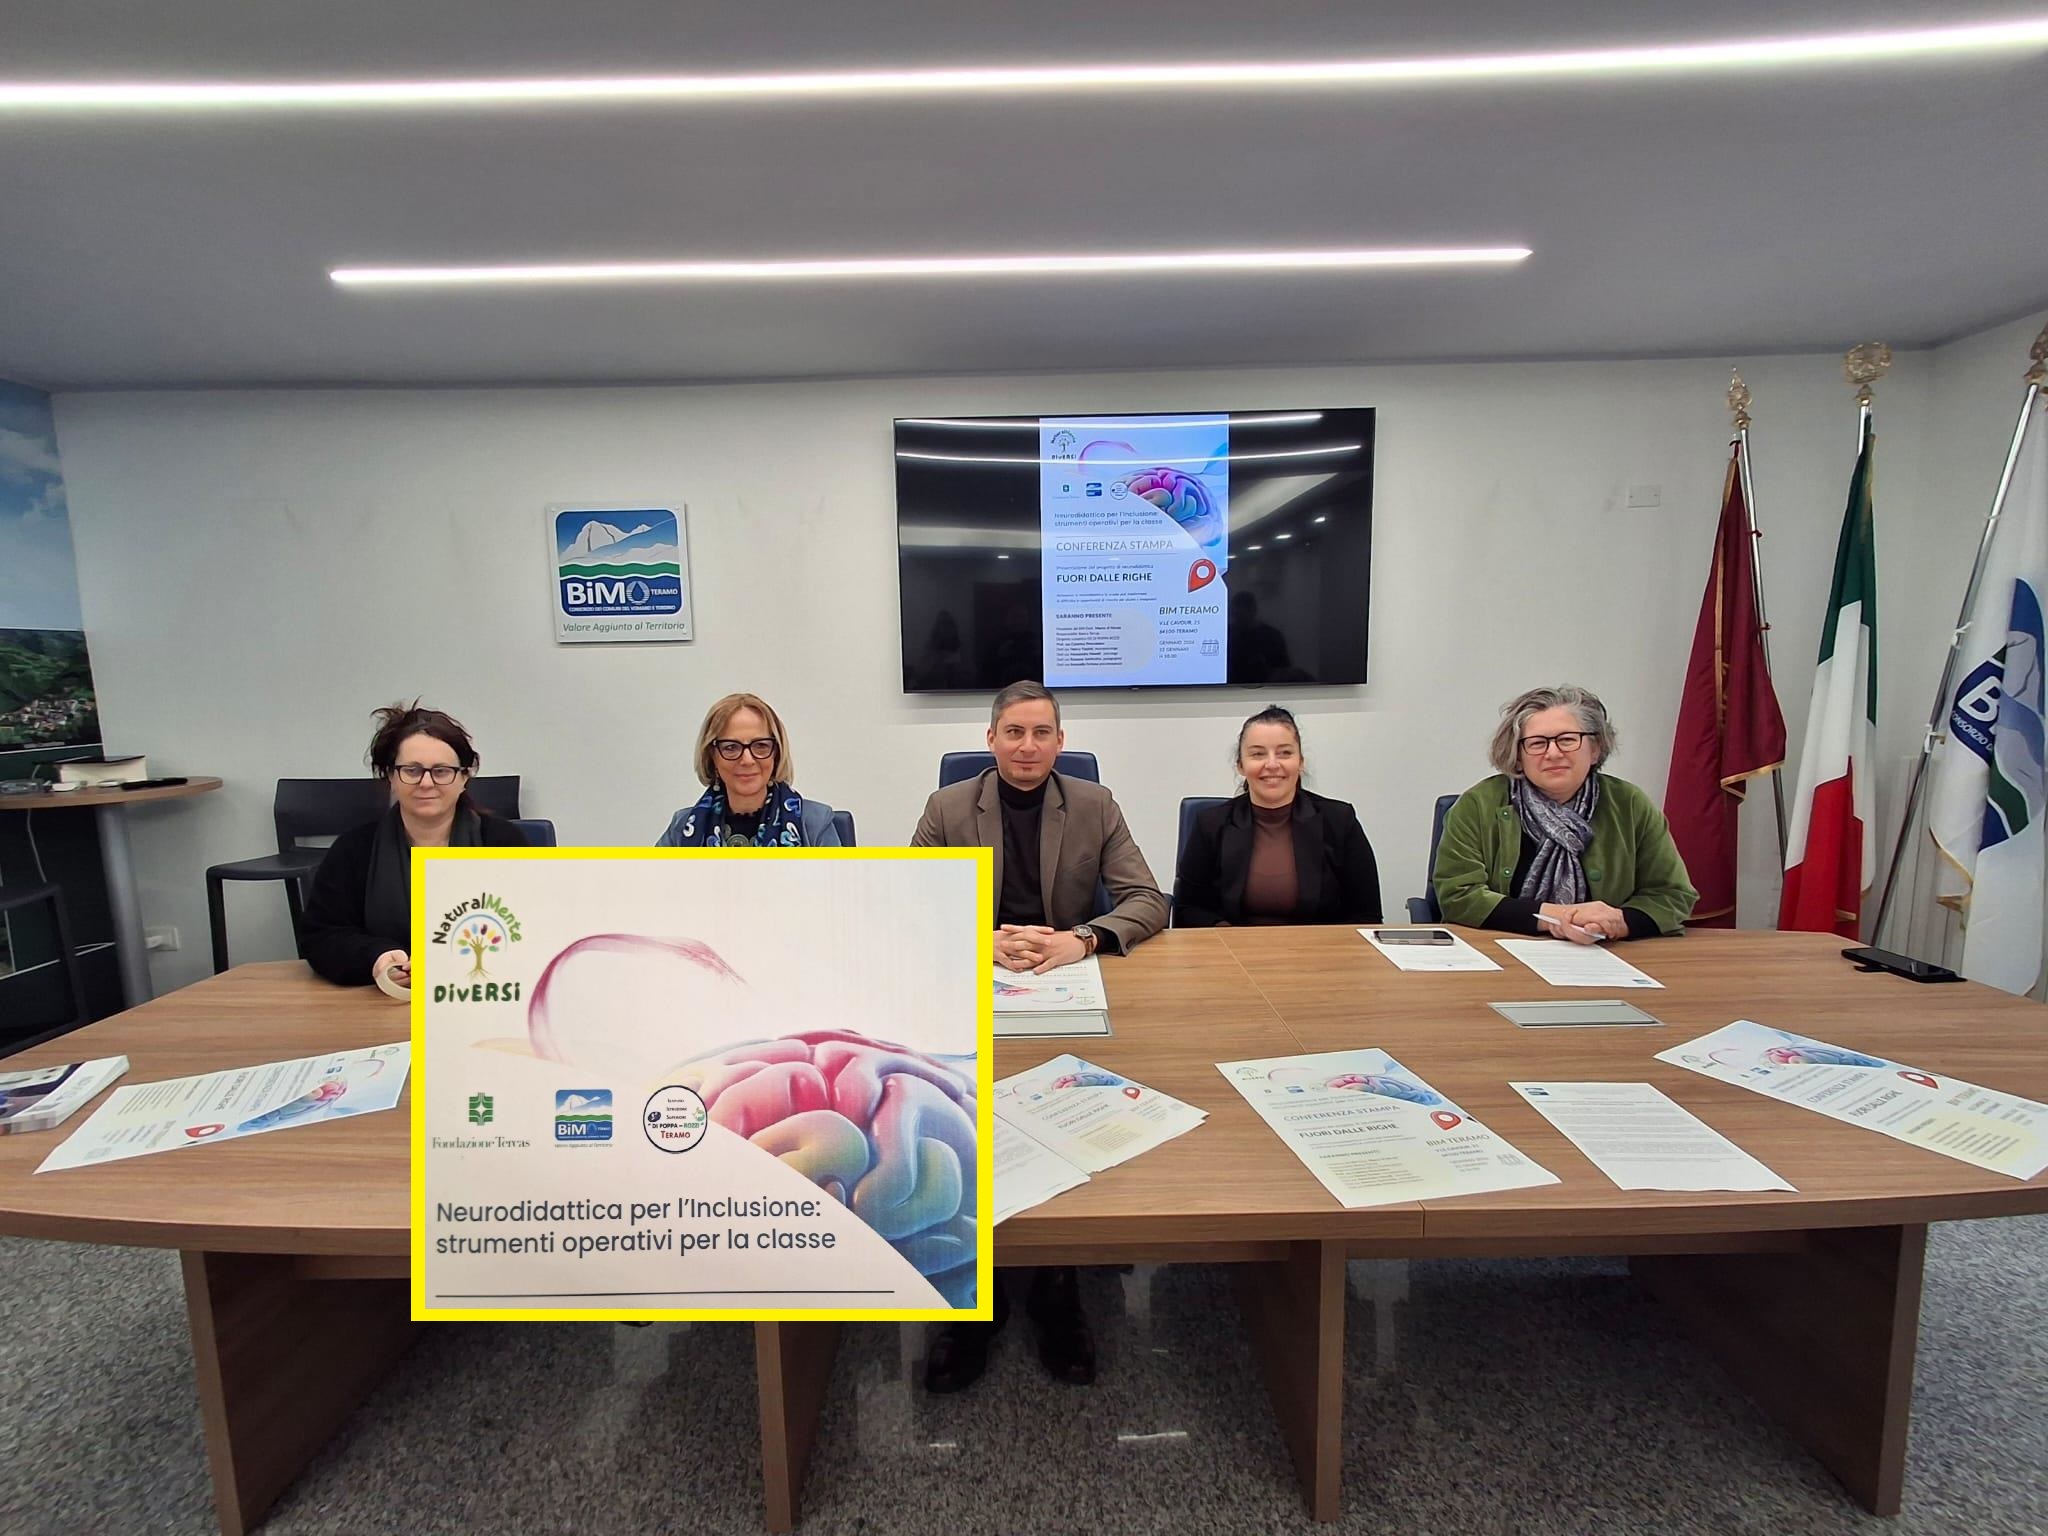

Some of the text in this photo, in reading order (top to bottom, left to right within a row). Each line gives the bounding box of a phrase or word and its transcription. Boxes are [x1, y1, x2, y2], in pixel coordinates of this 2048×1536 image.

[1056, 539, 1174, 551] CONFERENZA STAMPA
[1056, 572, 1153, 583] FUORI DALLE RIGHE
[1159, 605, 1220, 615] BIM TERAMO
[563, 621, 685, 633] Valore Aggiunto al Territorio
[1284, 1105, 1401, 1122] CONFERENZA STAMPA
[1299, 1129, 1334, 1139] FUORI
[1333, 1126, 1368, 1136] DALLE
[1367, 1123, 1399, 1132] RIGHE
[1447, 1133, 1490, 1144] TERAMO
